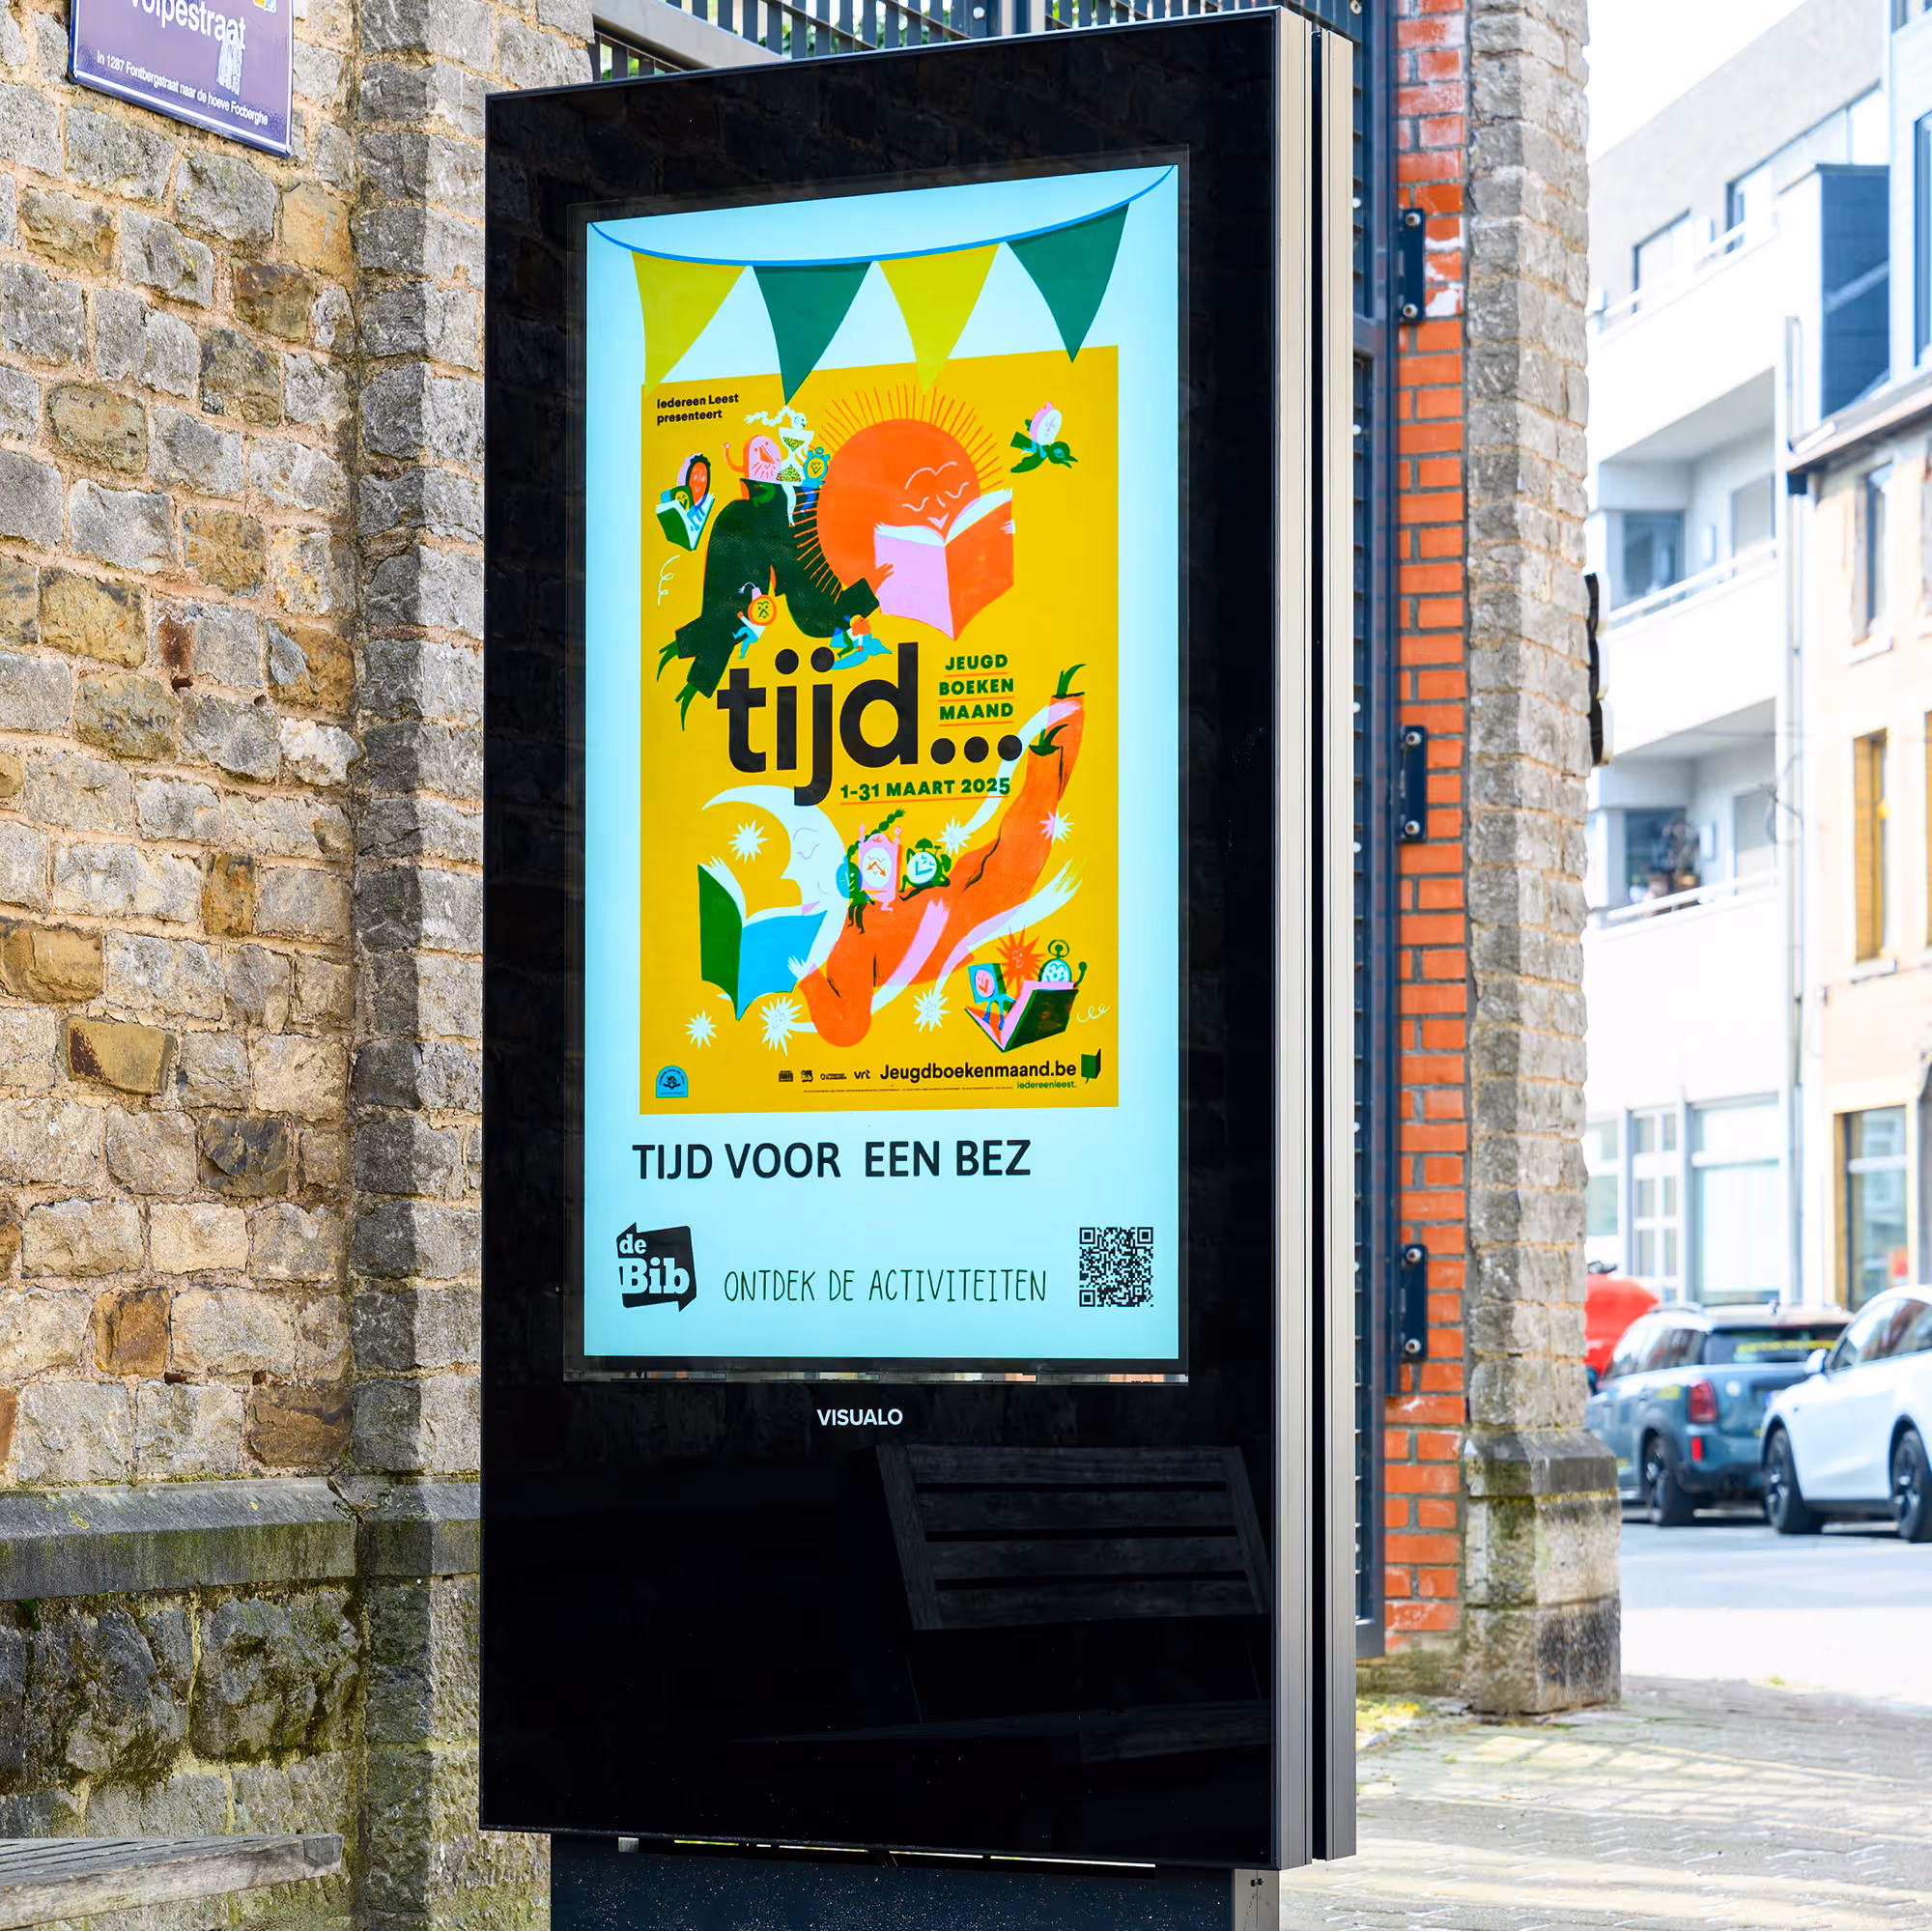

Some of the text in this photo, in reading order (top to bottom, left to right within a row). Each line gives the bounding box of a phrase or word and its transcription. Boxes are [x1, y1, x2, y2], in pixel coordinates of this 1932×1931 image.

[131, 0, 246, 50] opestraat
[97, 50, 105, 66] In
[107, 54, 125, 72] 1287
[180, 84, 197, 99] naar
[197, 89, 208, 103] de
[208, 92, 230, 112] hoeve
[656, 393, 739, 410] Iedereen Leest
[657, 410, 723, 426] presenteert
[945, 654, 1009, 670] JEUGD
[939, 678, 1014, 696] BOEKEN
[939, 702, 1014, 721] MAAND
[839, 777, 1011, 802] 1-31 MAART 2025
[880, 1061, 1077, 1083] Jeugdboekenmaand.be
[632, 1139, 1032, 1179] TIJD VOOR EEN BEZ
[619, 1233, 647, 1255] de
[618, 1256, 691, 1295] Bib
[724, 1268, 1046, 1302] ONTDEK DE ACTIVITEITEN
[816, 1408, 903, 1426] VISUALO
